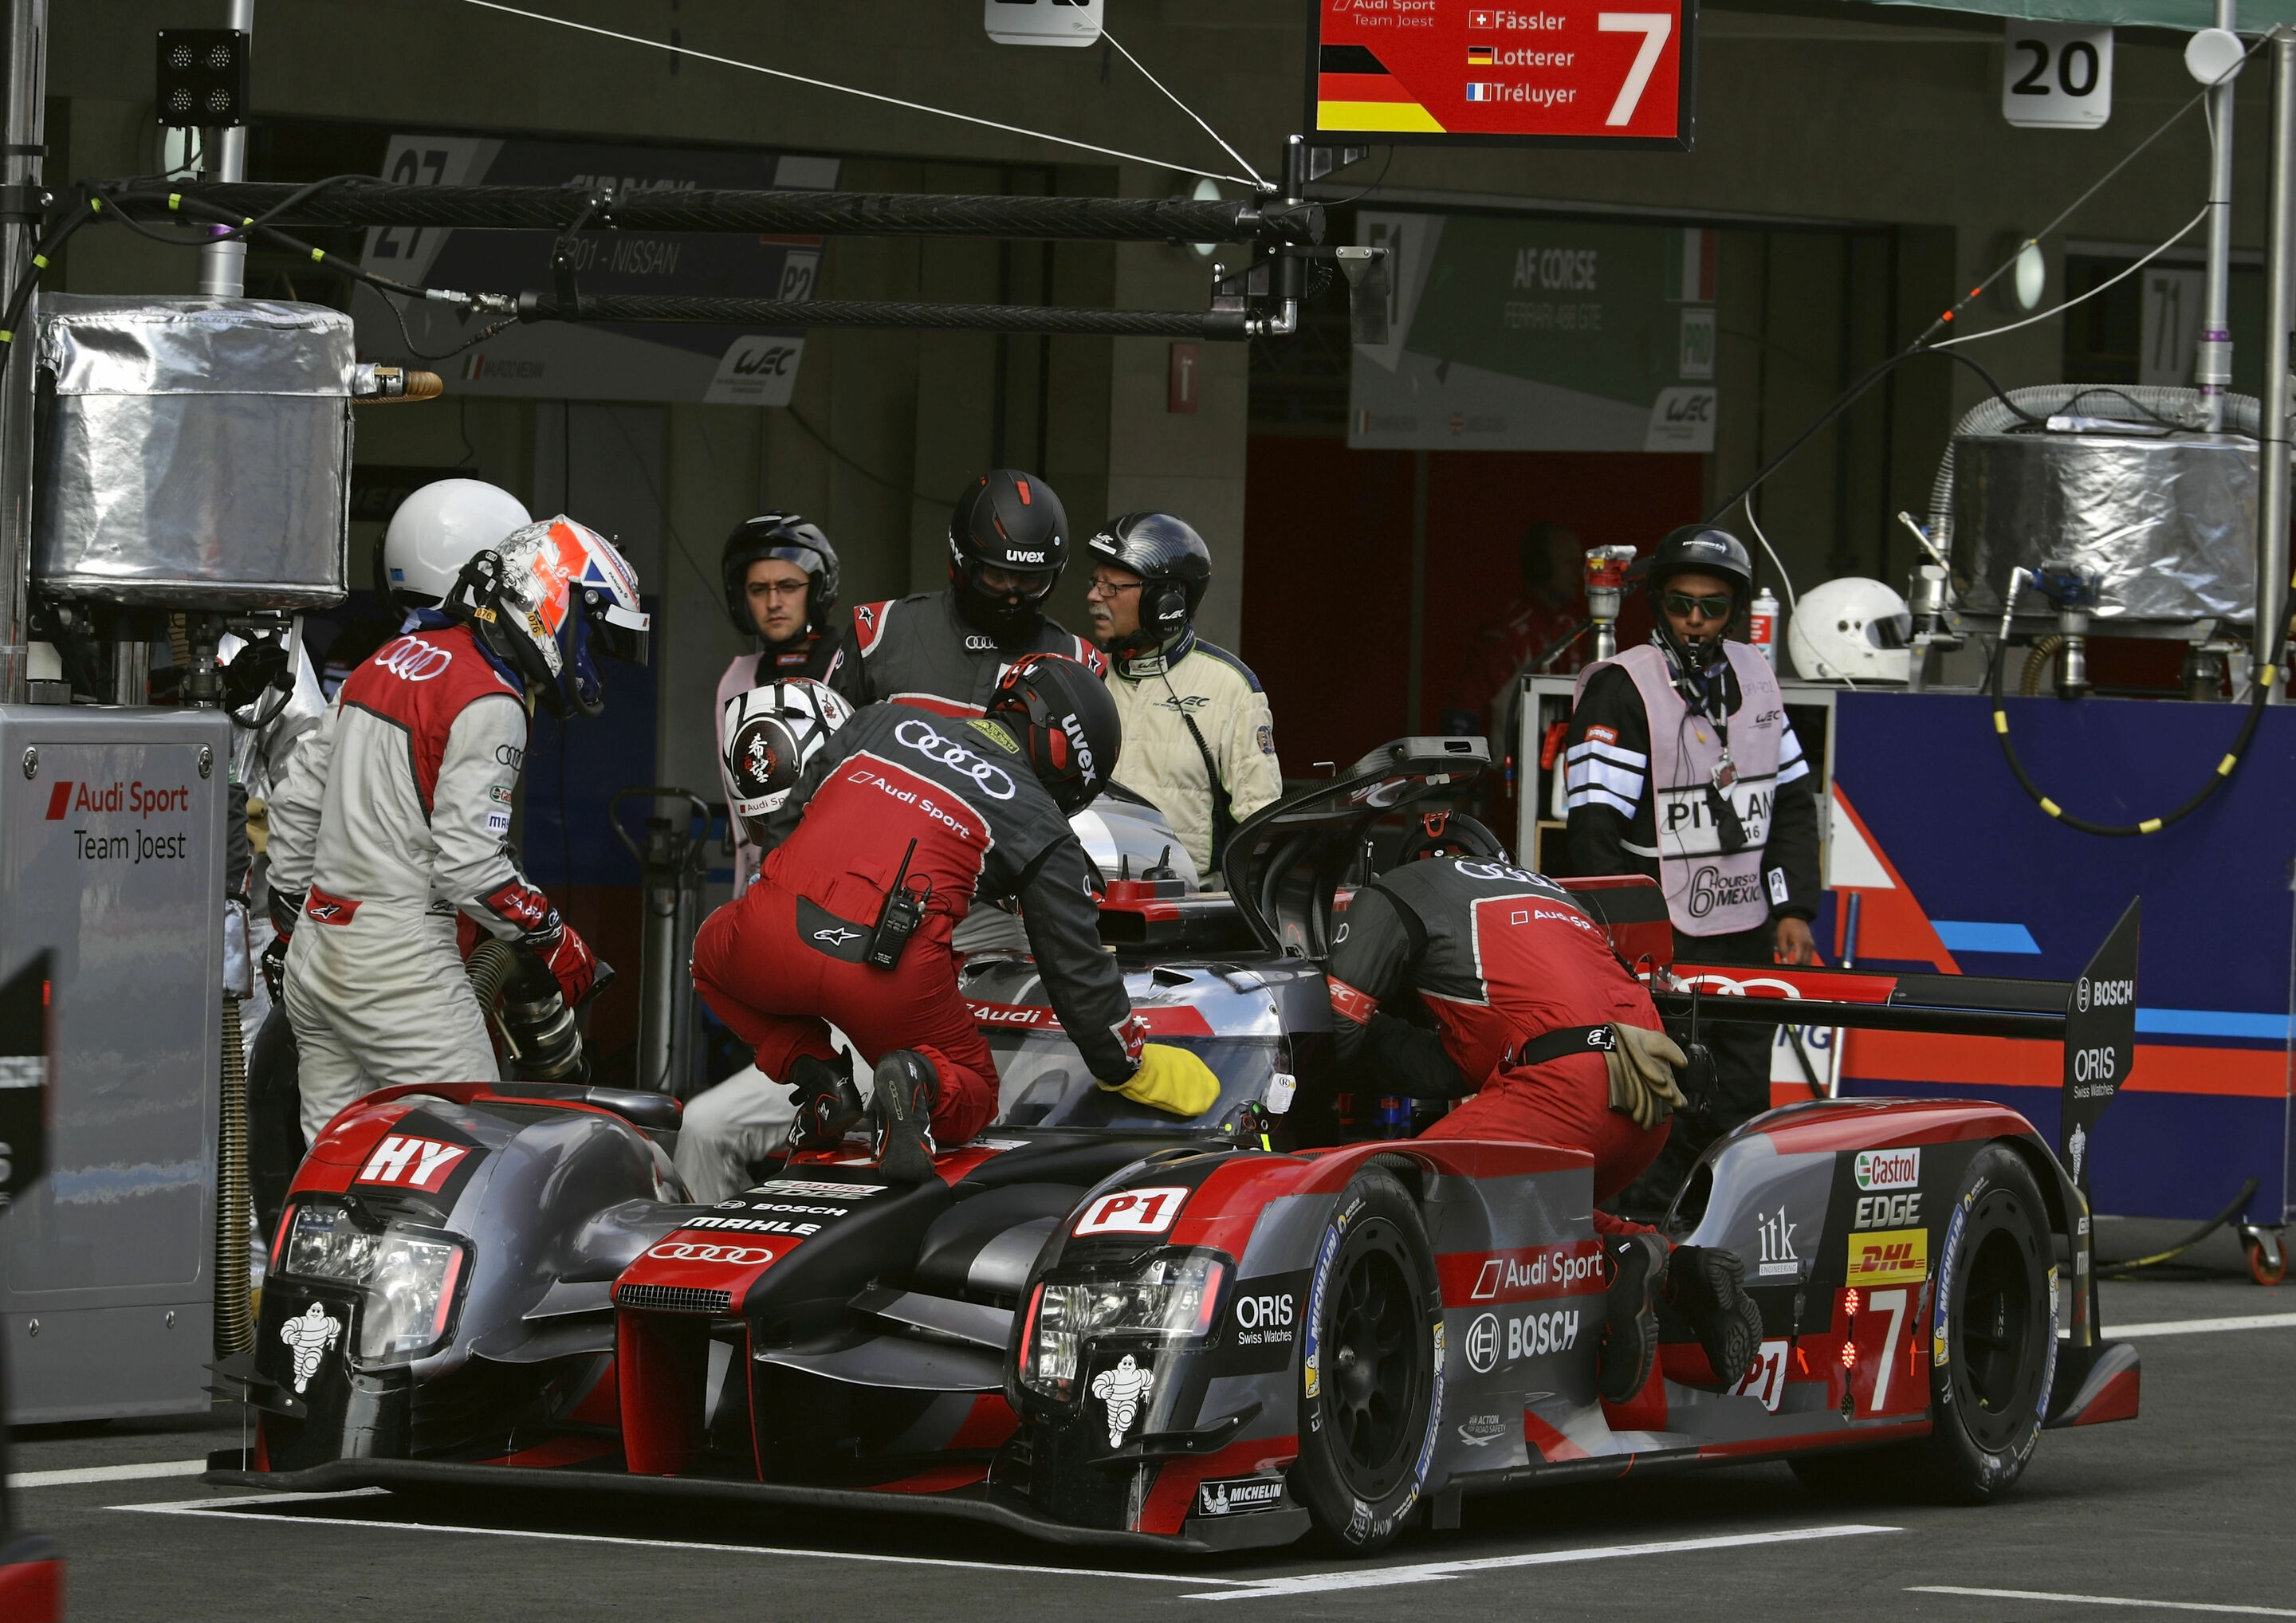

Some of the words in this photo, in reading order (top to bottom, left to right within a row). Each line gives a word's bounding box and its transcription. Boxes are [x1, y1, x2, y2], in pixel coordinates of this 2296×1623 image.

[1353, 14, 1393, 26] Team
[1396, 14, 1435, 28] Joest
[1495, 10, 1566, 31] Fässler
[1493, 49, 1575, 67] Lotterer
[1597, 13, 1673, 127] 7
[2012, 40, 2098, 96] 20
[1493, 84, 1577, 108] Tréluyer
[611, 241, 680, 274] NISSAN
[1514, 249, 1537, 288] AF
[1540, 249, 1598, 289] CORSE
[777, 265, 812, 301] P2
[733, 347, 796, 375] WEC
[1665, 395, 1712, 422] WEC
[1096, 532, 1114, 544] WEC
[1005, 550, 1045, 563] uvex
[478, 608, 493, 621] 076
[528, 615, 541, 633] 076
[1158, 609, 1185, 620] WEC
[1166, 695, 1209, 707] WEC
[1755, 709, 1780, 724] WEC
[1062, 713, 1098, 786] uvex
[75, 782, 124, 812] Audi
[129, 781, 188, 819] Sport
[501, 789, 513, 802] Cas
[747, 800, 769, 812] Audi
[770, 796, 785, 806] Sp
[871, 776, 918, 804] Audi
[919, 798, 971, 839] Sport
[74, 830, 129, 859] Team
[135, 829, 186, 864] Joest
[1689, 866, 1719, 918] 6
[1709, 874, 1747, 890] HOURS
[1716, 886, 1761, 907] MEXIC
[1533, 909, 1570, 922] Audi
[1329, 984, 1356, 1002] EC
[2093, 980, 2133, 1007] BOSCH
[973, 1006, 1042, 1024] Audi
[2074, 1046, 2115, 1083] ORIS
[2074, 1084, 2090, 1099] Swiss
[2090, 1083, 2114, 1098] Watches
[360, 1137, 465, 1185] HY
[1871, 1153, 1916, 1185] Castrol
[743, 1187, 875, 1200] EDGE
[791, 1181, 874, 1193] Castrol
[751, 1203, 848, 1216] BOSCH
[1093, 1193, 1163, 1225] P1
[1854, 1193, 1922, 1228] EDGE
[681, 1216, 822, 1236] MAHLE
[1758, 1204, 1798, 1262] itk
[1504, 1254, 1548, 1289] Audi
[1551, 1251, 1603, 1287] Sport
[1760, 1264, 1797, 1275] ENGINEERING
[1861, 1243, 1917, 1272] DHL
[1940, 1212, 1964, 1313] MICHELIN
[1311, 1232, 1337, 1341] MICHELIN
[1236, 1294, 1293, 1329] ORIS
[1238, 1330, 1262, 1346] Swiss
[1264, 1329, 1292, 1344] Watches
[1508, 1310, 1579, 1360] BOSCH
[1869, 1289, 1908, 1411] 7
[1735, 1349, 1779, 1402] P1
[1477, 1415, 1500, 1425] ACTION
[1489, 1424, 1506, 1433] SAFETY
[1229, 1483, 1282, 1502] MICHELIN
